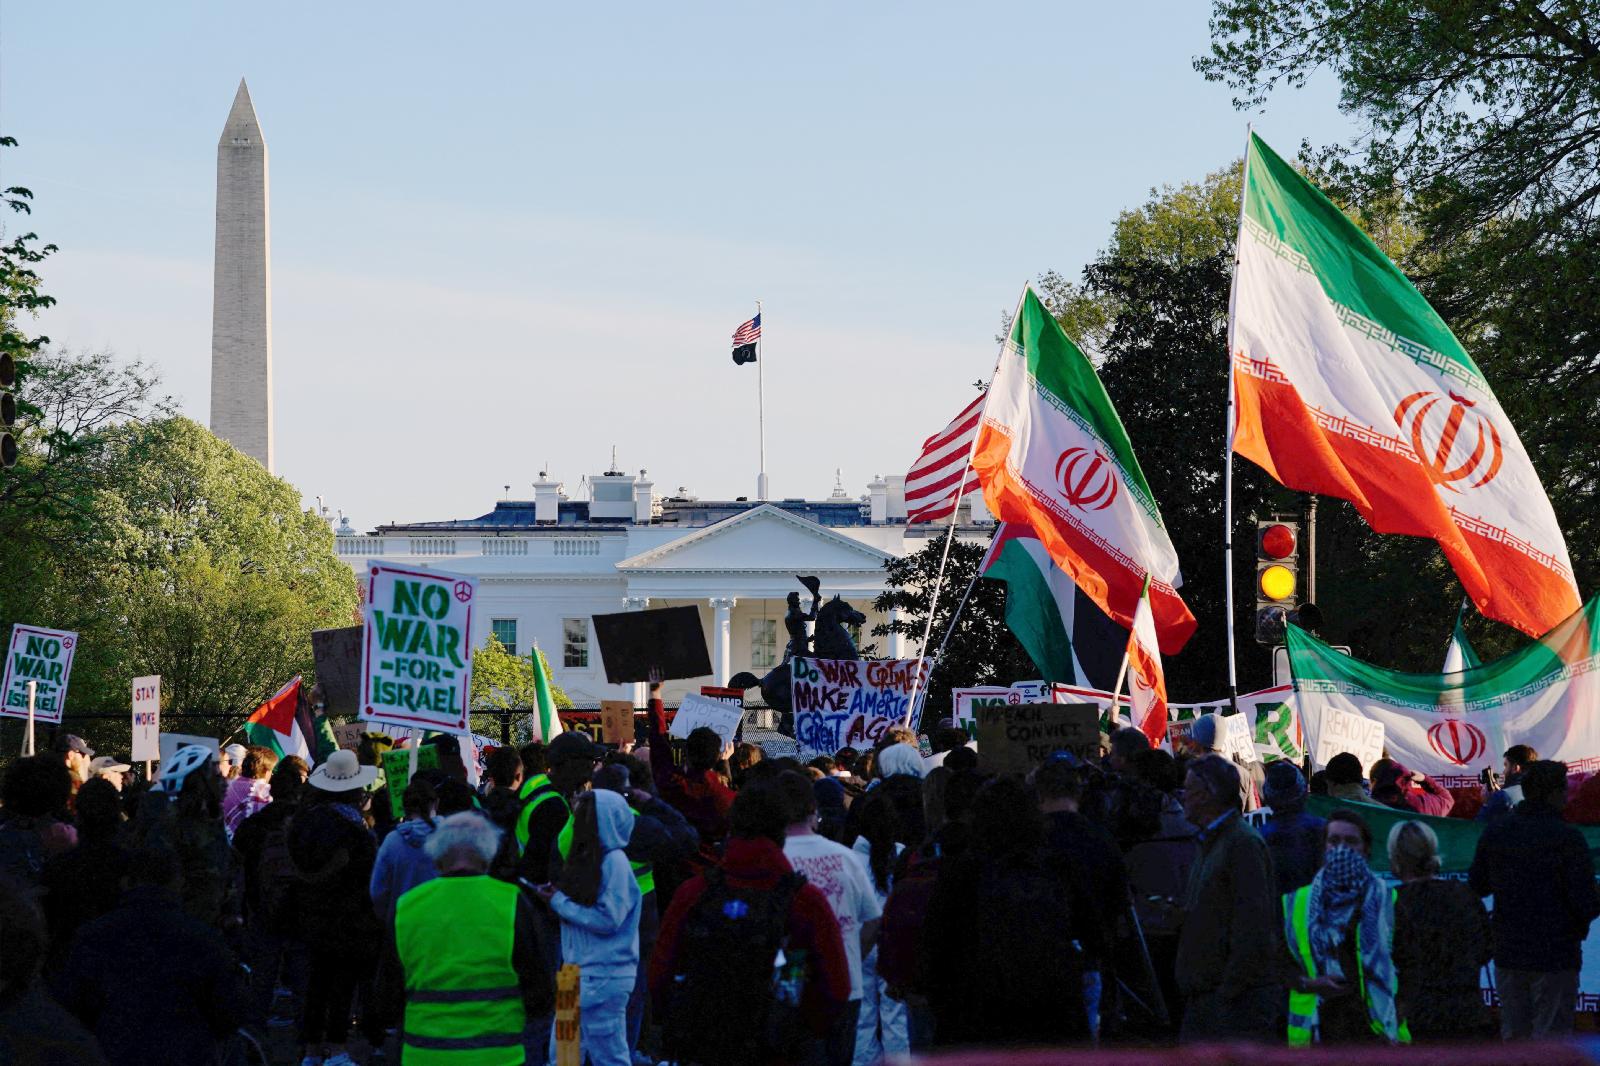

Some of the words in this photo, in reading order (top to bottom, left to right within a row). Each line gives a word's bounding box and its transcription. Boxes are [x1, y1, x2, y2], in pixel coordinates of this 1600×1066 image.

[392, 579, 450, 620] NO
[25, 635, 60, 659] NO
[372, 610, 465, 668] WAR
[14, 652, 63, 686] WAR
[815, 659, 862, 689] WAR
[135, 686, 156, 702] STAY
[372, 675, 462, 715] ISRAEL
[794, 681, 849, 713] MAKE
[135, 712, 156, 726] WOKE
[1171, 727, 1192, 737] IRAN
[1326, 708, 1383, 750] REMOVE
[1321, 740, 1375, 767] TRP
